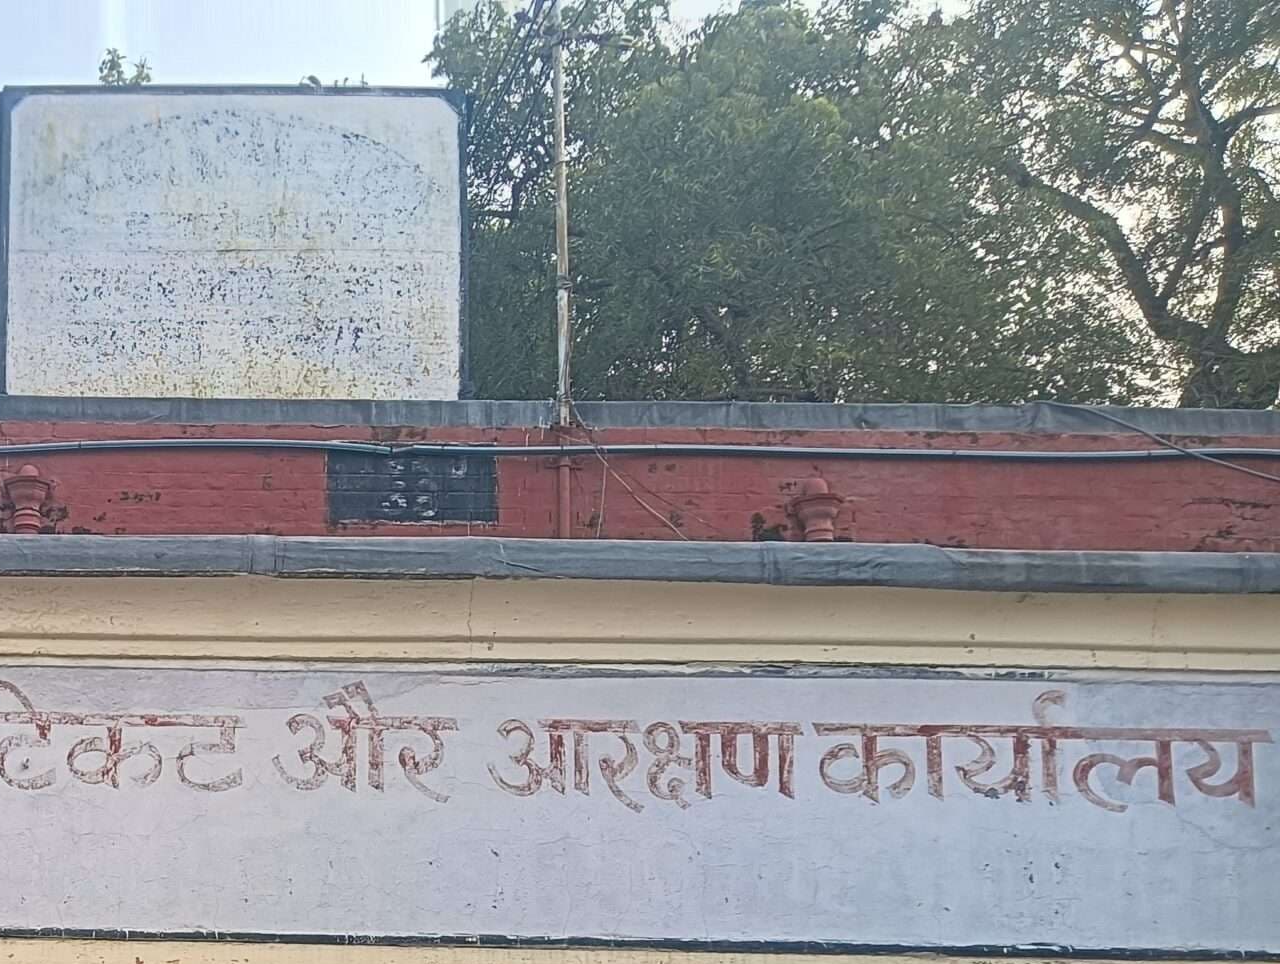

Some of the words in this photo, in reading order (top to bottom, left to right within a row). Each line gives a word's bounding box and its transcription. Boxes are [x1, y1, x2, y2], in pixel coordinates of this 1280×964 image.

[272, 680, 460, 803] और
[488, 718, 803, 813] आरक्षण
[812, 689, 1274, 813] कार्यालय
